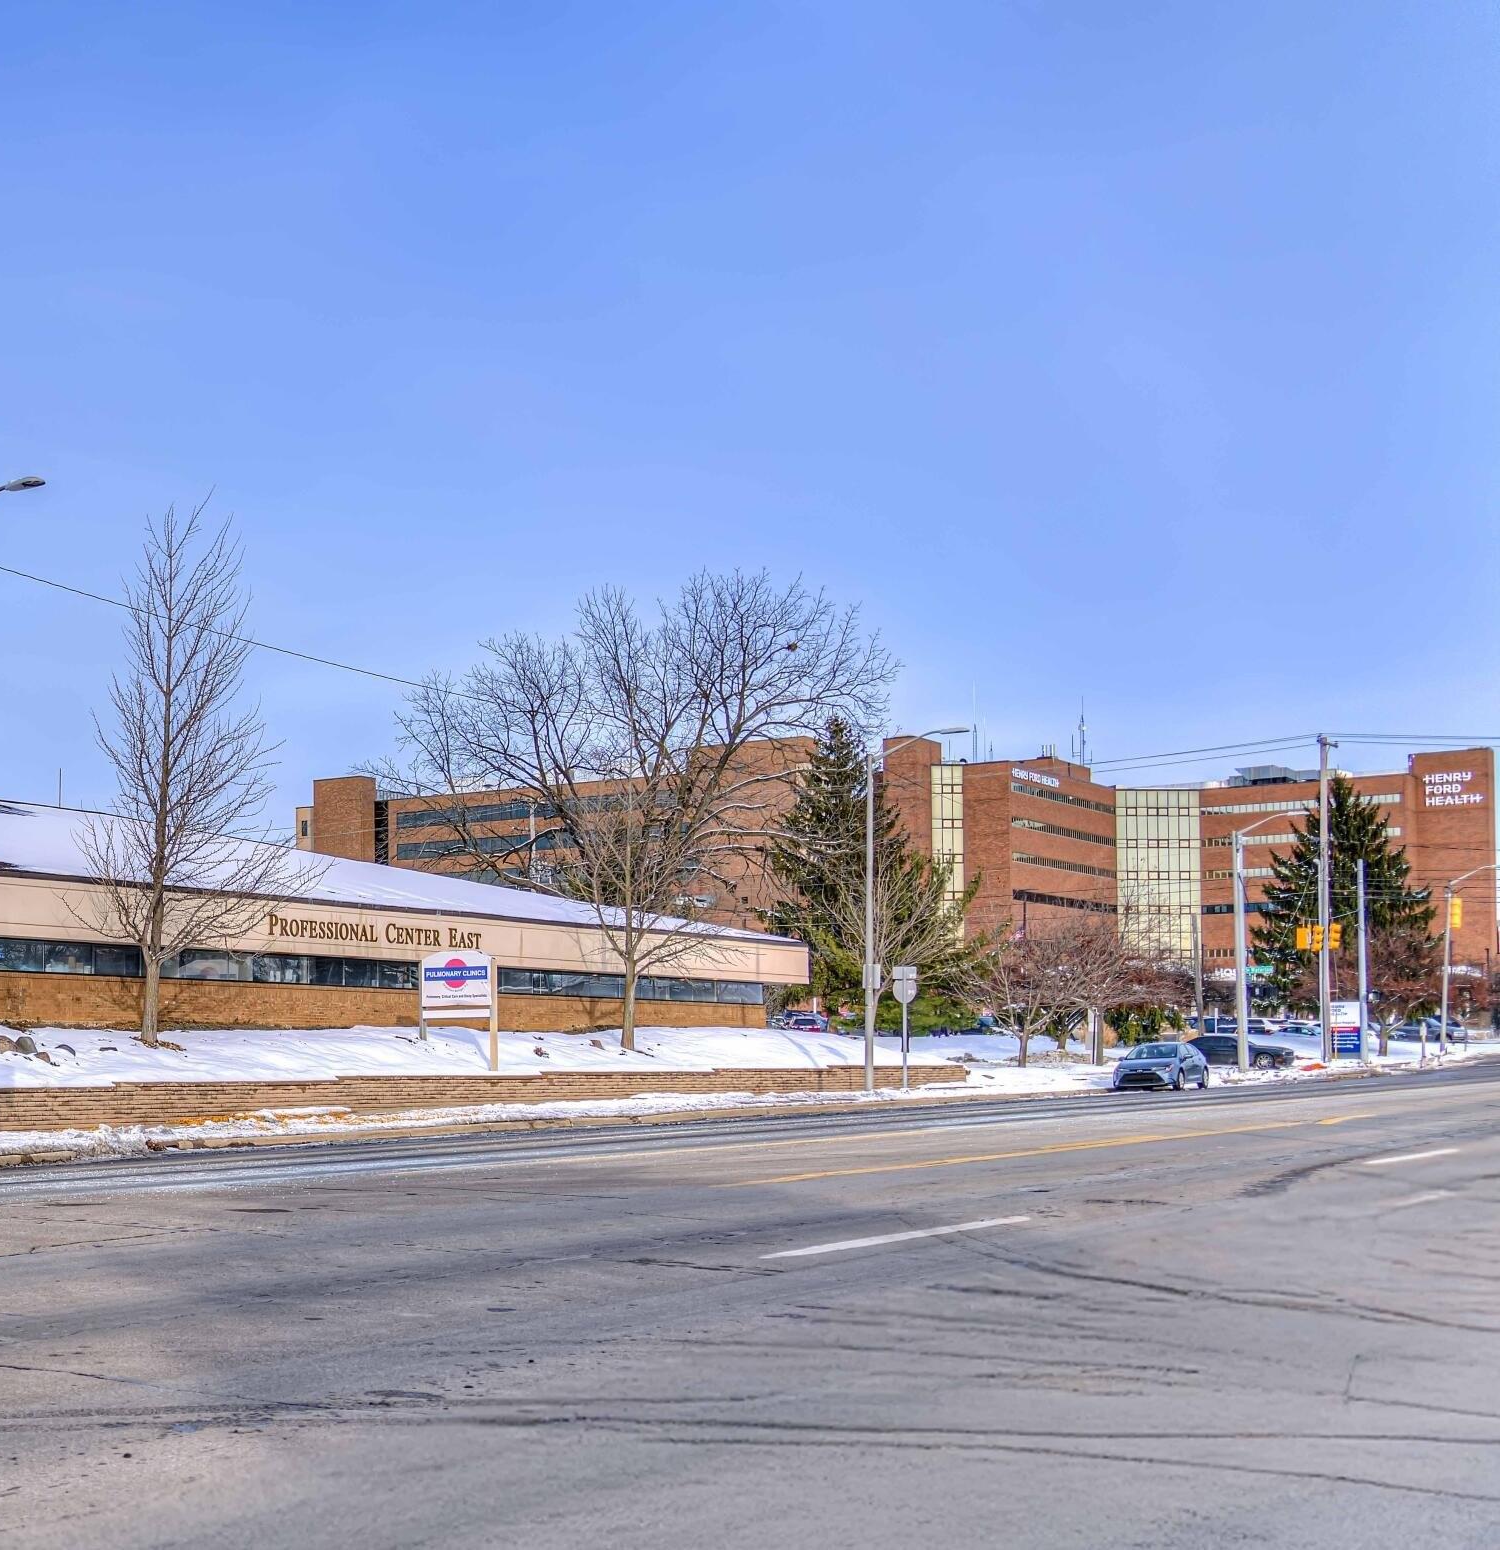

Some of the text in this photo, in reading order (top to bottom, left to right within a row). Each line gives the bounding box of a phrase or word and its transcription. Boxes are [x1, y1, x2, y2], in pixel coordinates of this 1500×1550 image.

[1423, 771, 1472, 784] HENRY
[1425, 784, 1462, 795] FORD
[1425, 794, 1484, 807] HEALTH
[268, 914, 482, 950] PROFESSIONAL CENTER EAST
[426, 969, 486, 978] PULMONARY CLINICS
